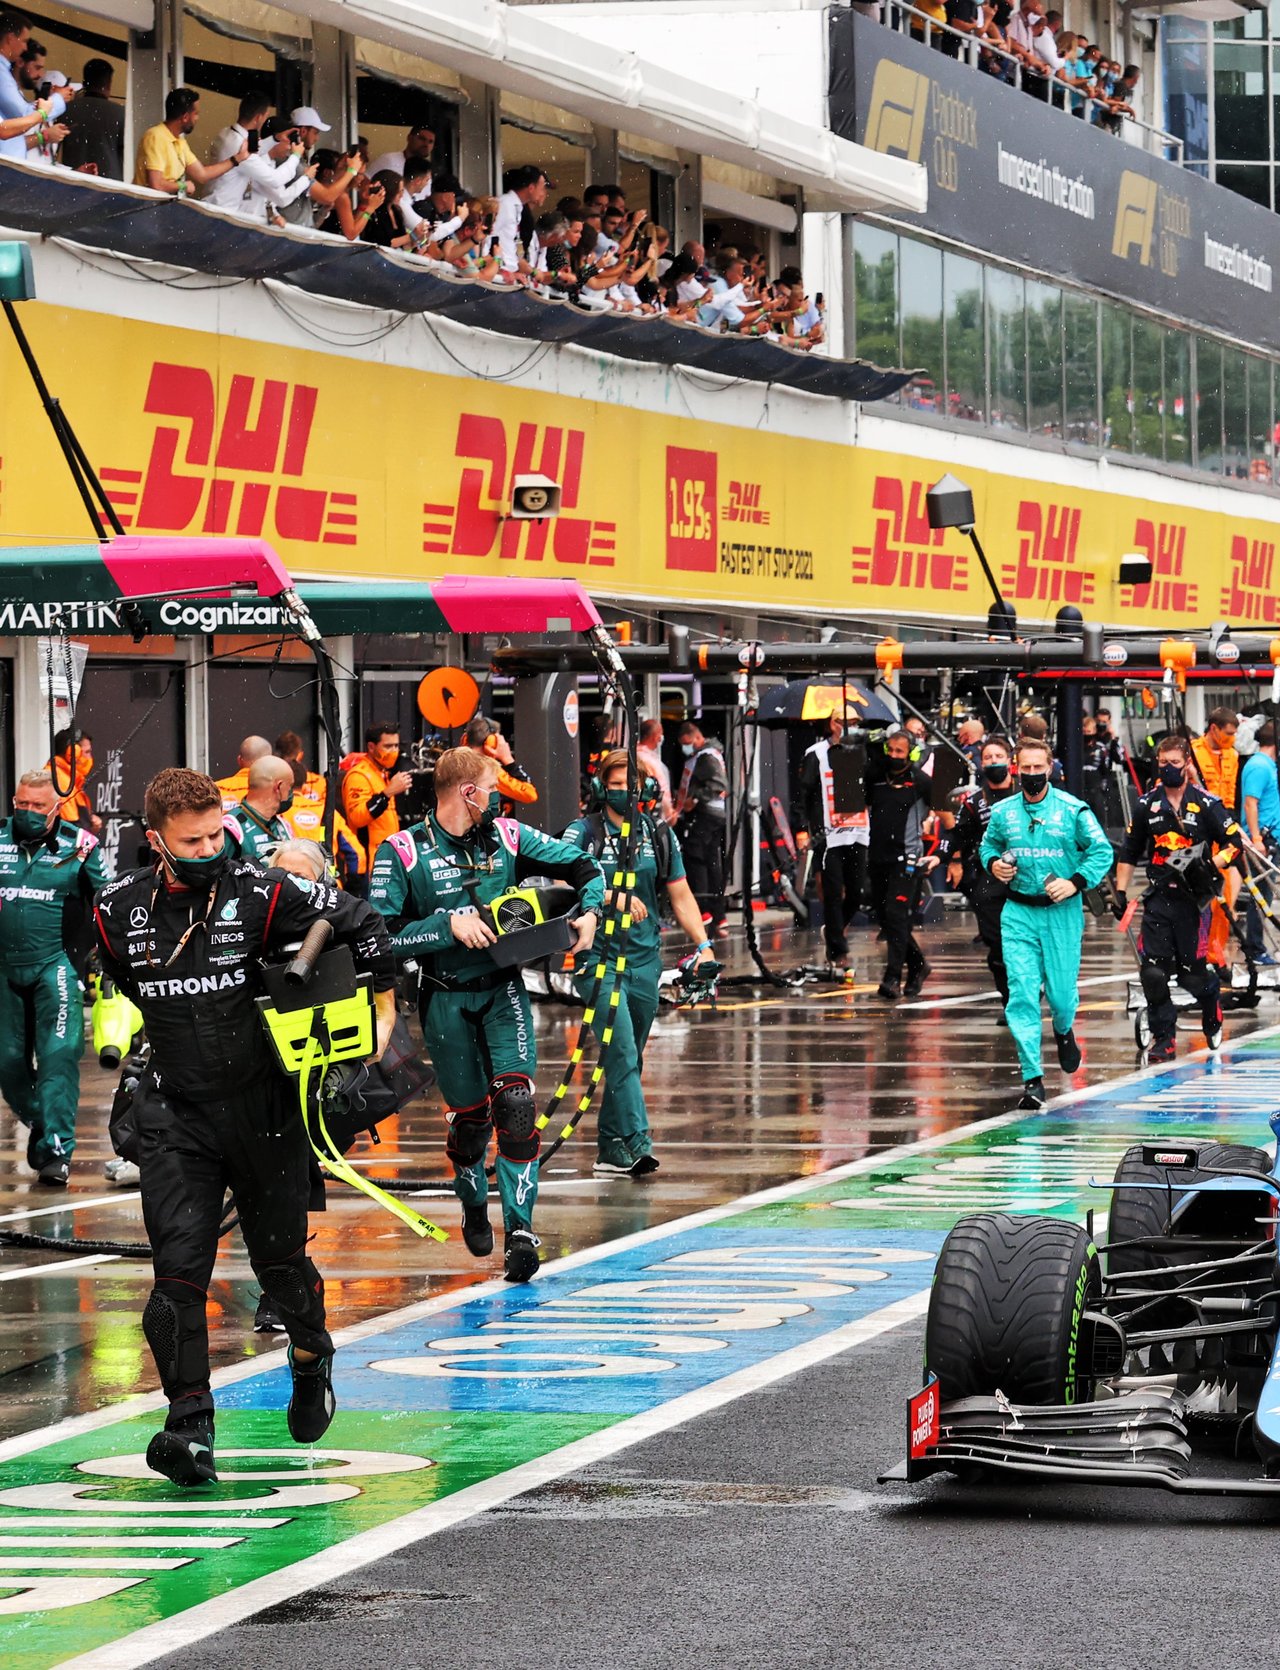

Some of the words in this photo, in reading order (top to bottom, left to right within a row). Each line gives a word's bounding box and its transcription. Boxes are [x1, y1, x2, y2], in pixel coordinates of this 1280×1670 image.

[136, 361, 327, 543] DHL
[451, 413, 593, 564] DHL
[728, 481, 763, 525] DHL
[871, 476, 955, 590] DHL
[720, 542, 756, 576] FASTEST
[757, 546, 773, 577] PIT
[773, 548, 795, 579] STOP
[1016, 501, 1084, 603] DHL
[1132, 518, 1188, 612] DHL
[1229, 535, 1277, 622] DHL
[428, 854, 456, 870] BWT
[435, 869, 460, 880] JCB
[0, 886, 54, 902] ognizant
[211, 932, 244, 945] INEOS
[404, 931, 440, 946] MARTIN
[58, 965, 68, 1002] MARTIN
[138, 968, 247, 999] PETRONAS
[507, 981, 525, 1022] MARTIN
[54, 1003, 68, 1040] ASTON
[516, 1022, 528, 1061] ASTON
[1161, 1154, 1185, 1163] Castrol
[418, 1219, 435, 1234] REAR
